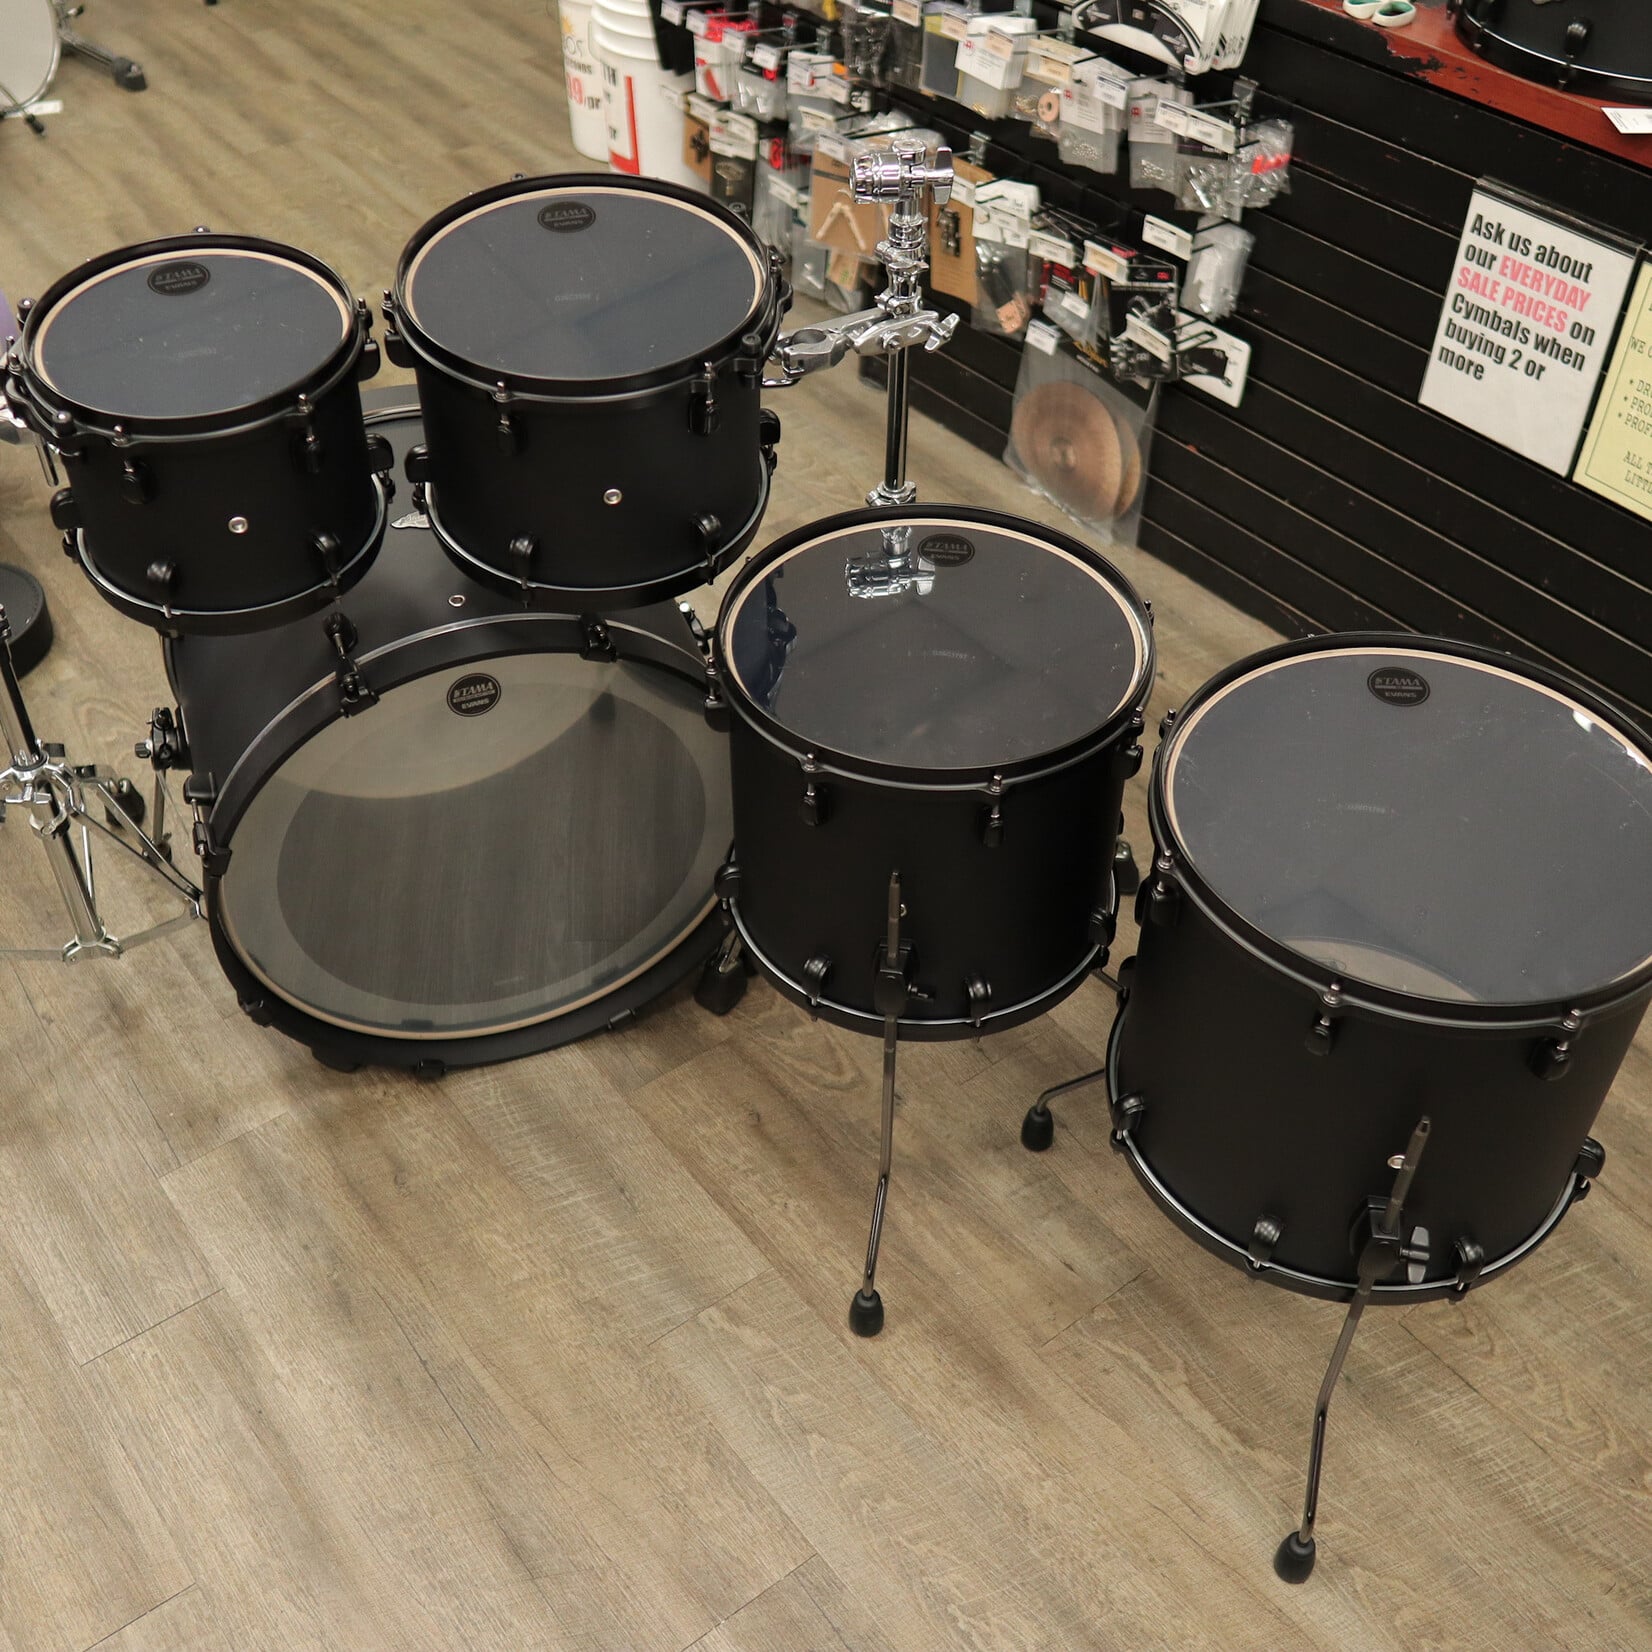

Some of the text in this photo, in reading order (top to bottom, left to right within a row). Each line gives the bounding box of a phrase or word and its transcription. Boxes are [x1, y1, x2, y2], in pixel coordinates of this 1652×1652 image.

[1470, 213, 1593, 284] Ask us about
[1464, 244, 1592, 312] our EVERYDAY
[1457, 266, 1596, 346] SALE PRICES on
[1452, 292, 1586, 372] Cymbals when
[1437, 345, 1485, 381] more
[1444, 317, 1546, 381] buying 2 or
[1636, 379, 1652, 399] DR
[1630, 396, 1652, 418] PRO
[1624, 412, 1652, 438] PROF
[1623, 450, 1642, 470] ALL
[460, 681, 495, 697] TAMA
[1384, 677, 1421, 687] TAMA
